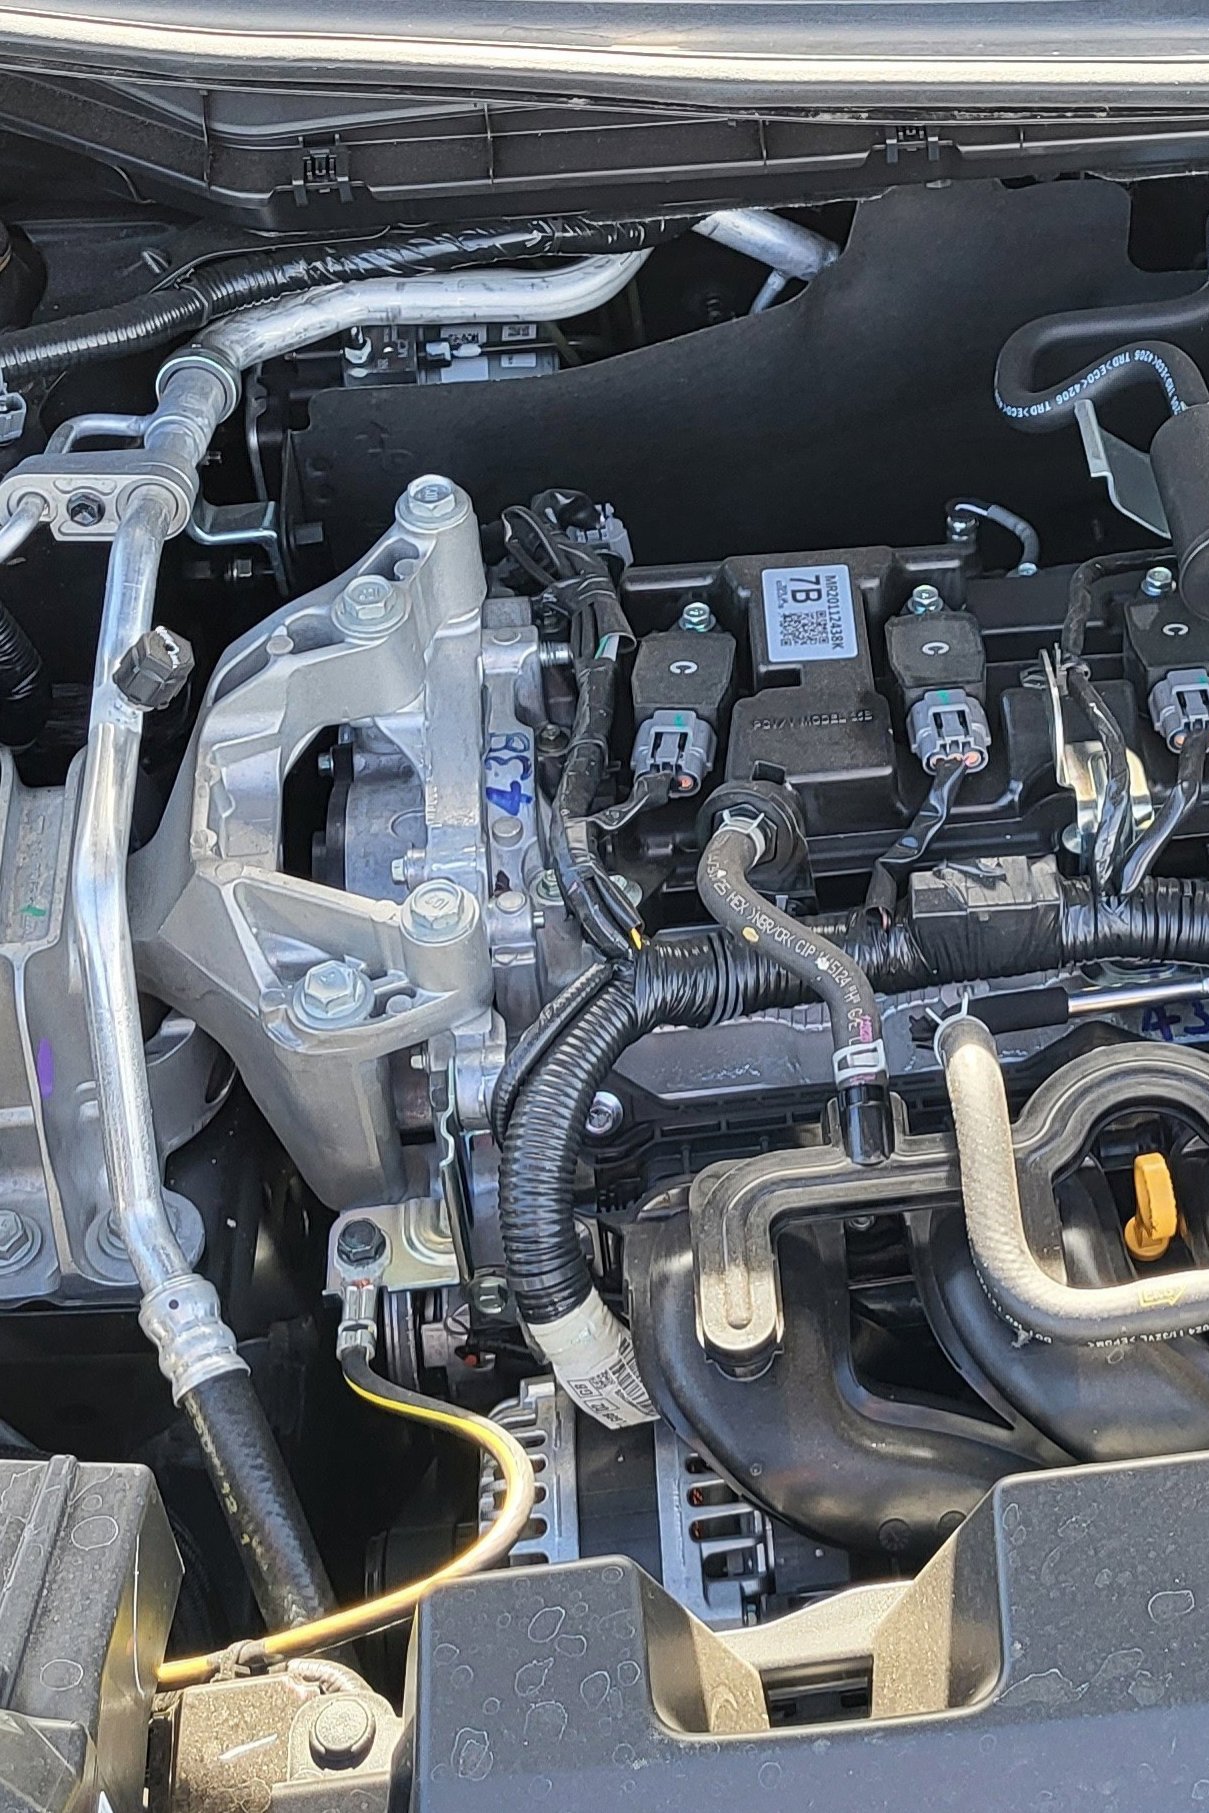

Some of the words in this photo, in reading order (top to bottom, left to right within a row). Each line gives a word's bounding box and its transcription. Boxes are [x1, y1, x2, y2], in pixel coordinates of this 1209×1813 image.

[789, 575, 822, 603] 7B
[825, 575, 844, 650] MR20112438K
[800, 714, 847, 727] MODEL
[726, 891, 749, 915] MEX
[794, 941, 816, 958] CIP
